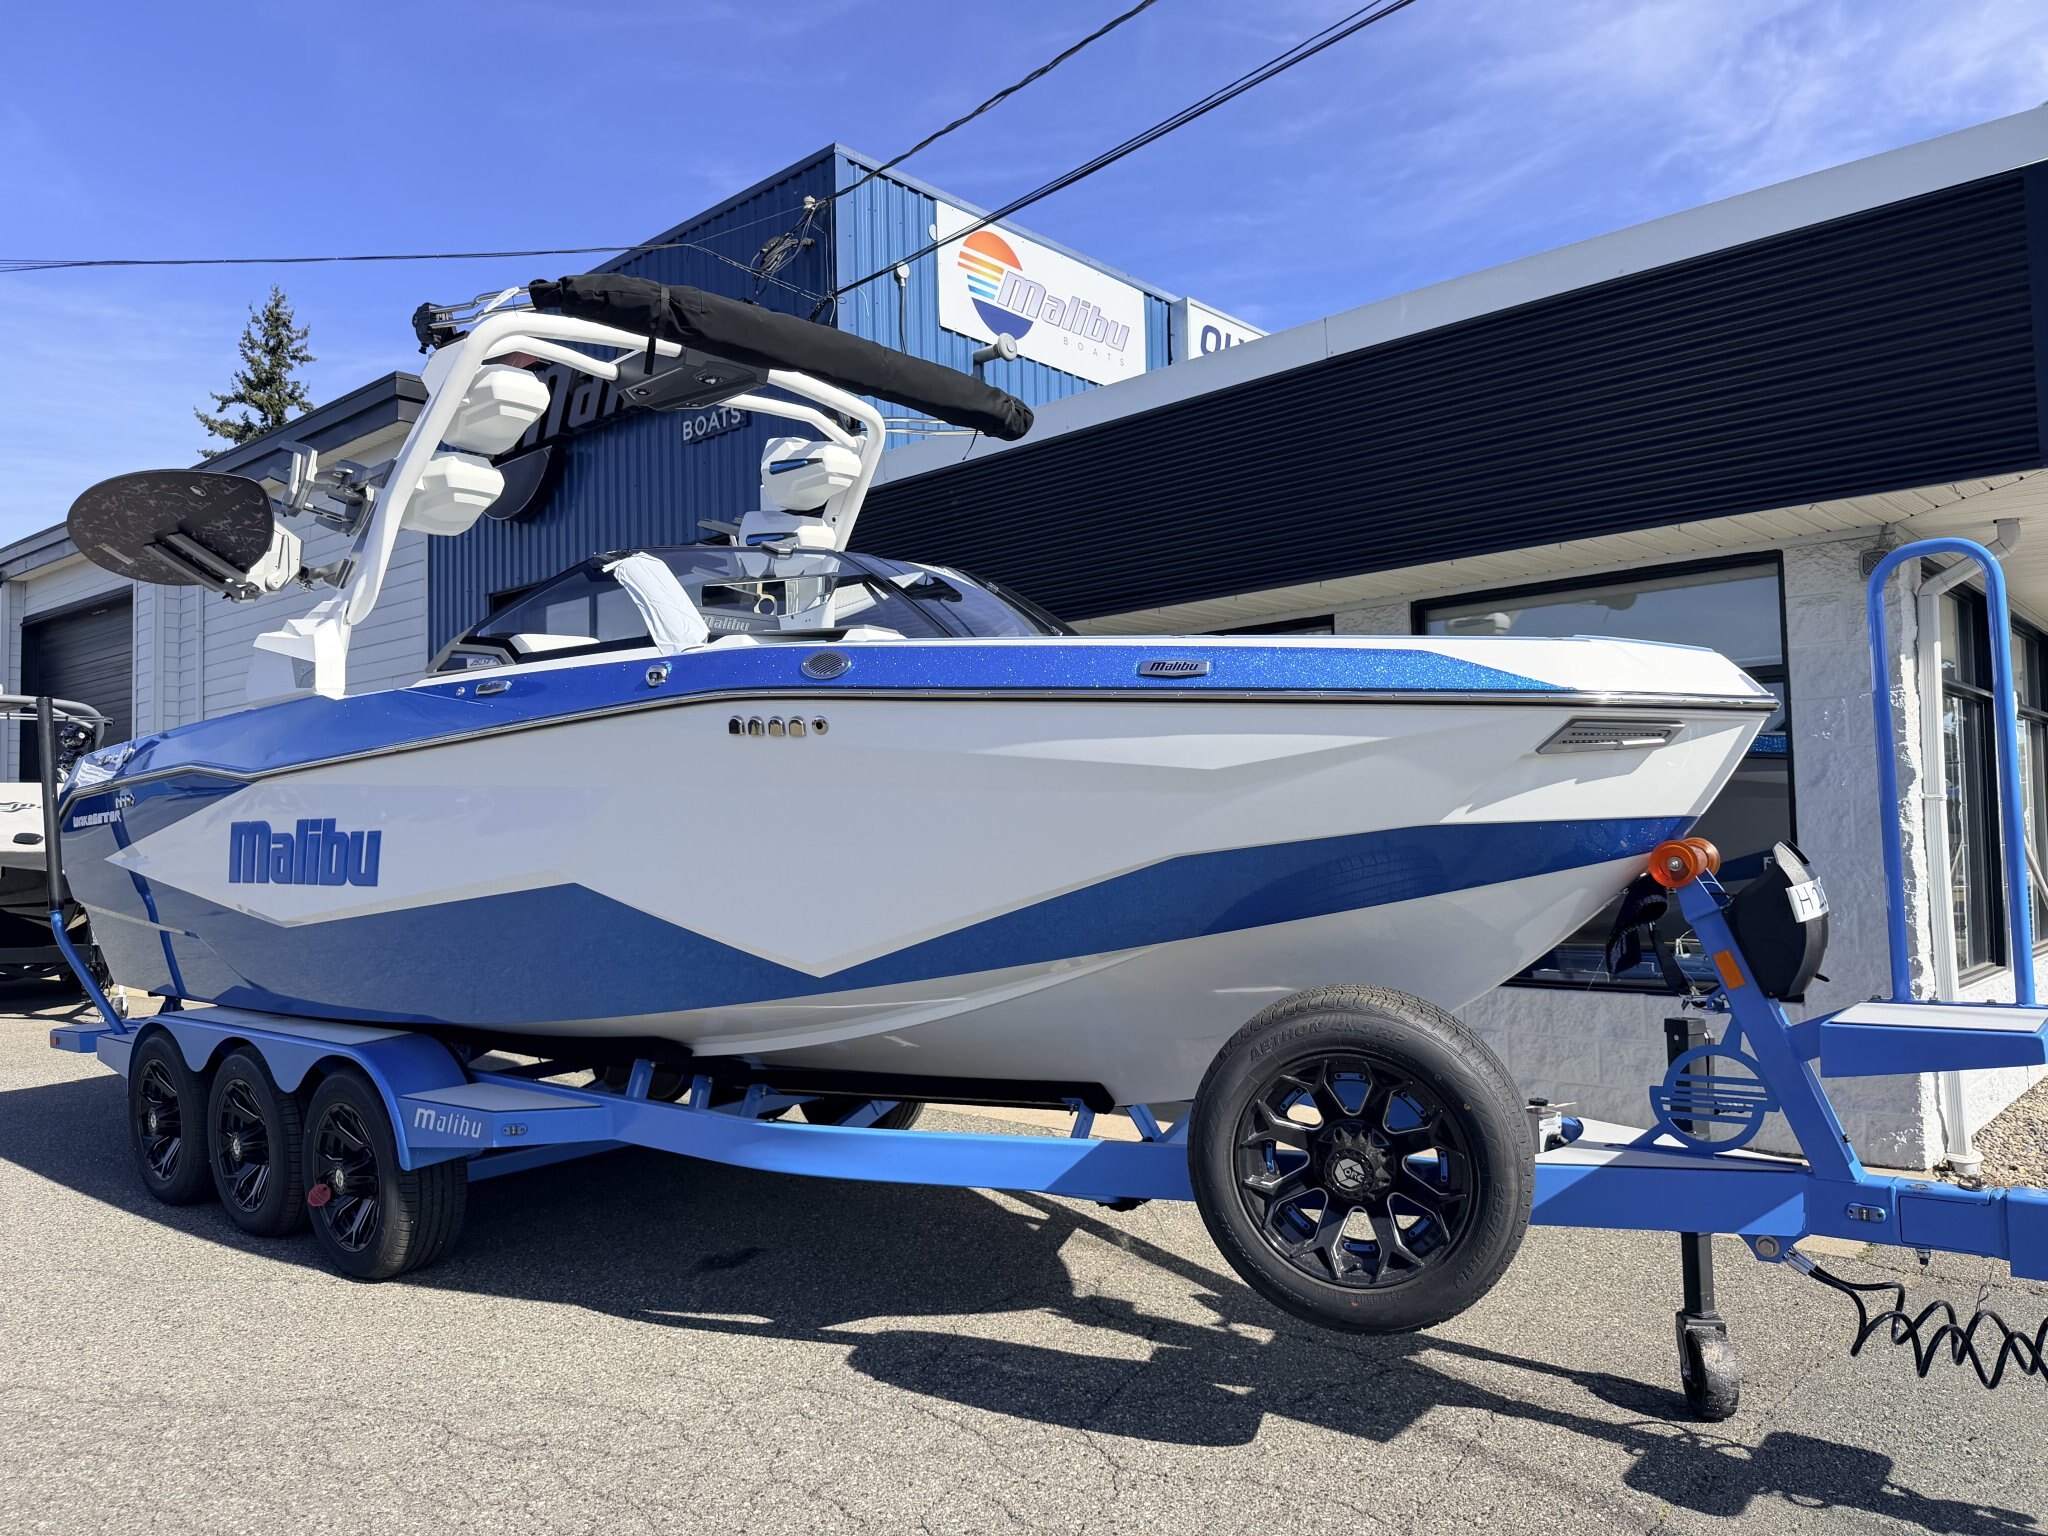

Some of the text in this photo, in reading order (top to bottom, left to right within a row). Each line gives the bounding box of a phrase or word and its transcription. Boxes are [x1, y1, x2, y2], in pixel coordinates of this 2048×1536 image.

[996, 270, 1130, 352] Malibu
[1063, 336, 1125, 367] BOATS
[683, 407, 741, 440] BOATS
[1149, 661, 1199, 671] Malibu
[229, 818, 382, 887] Malibu
